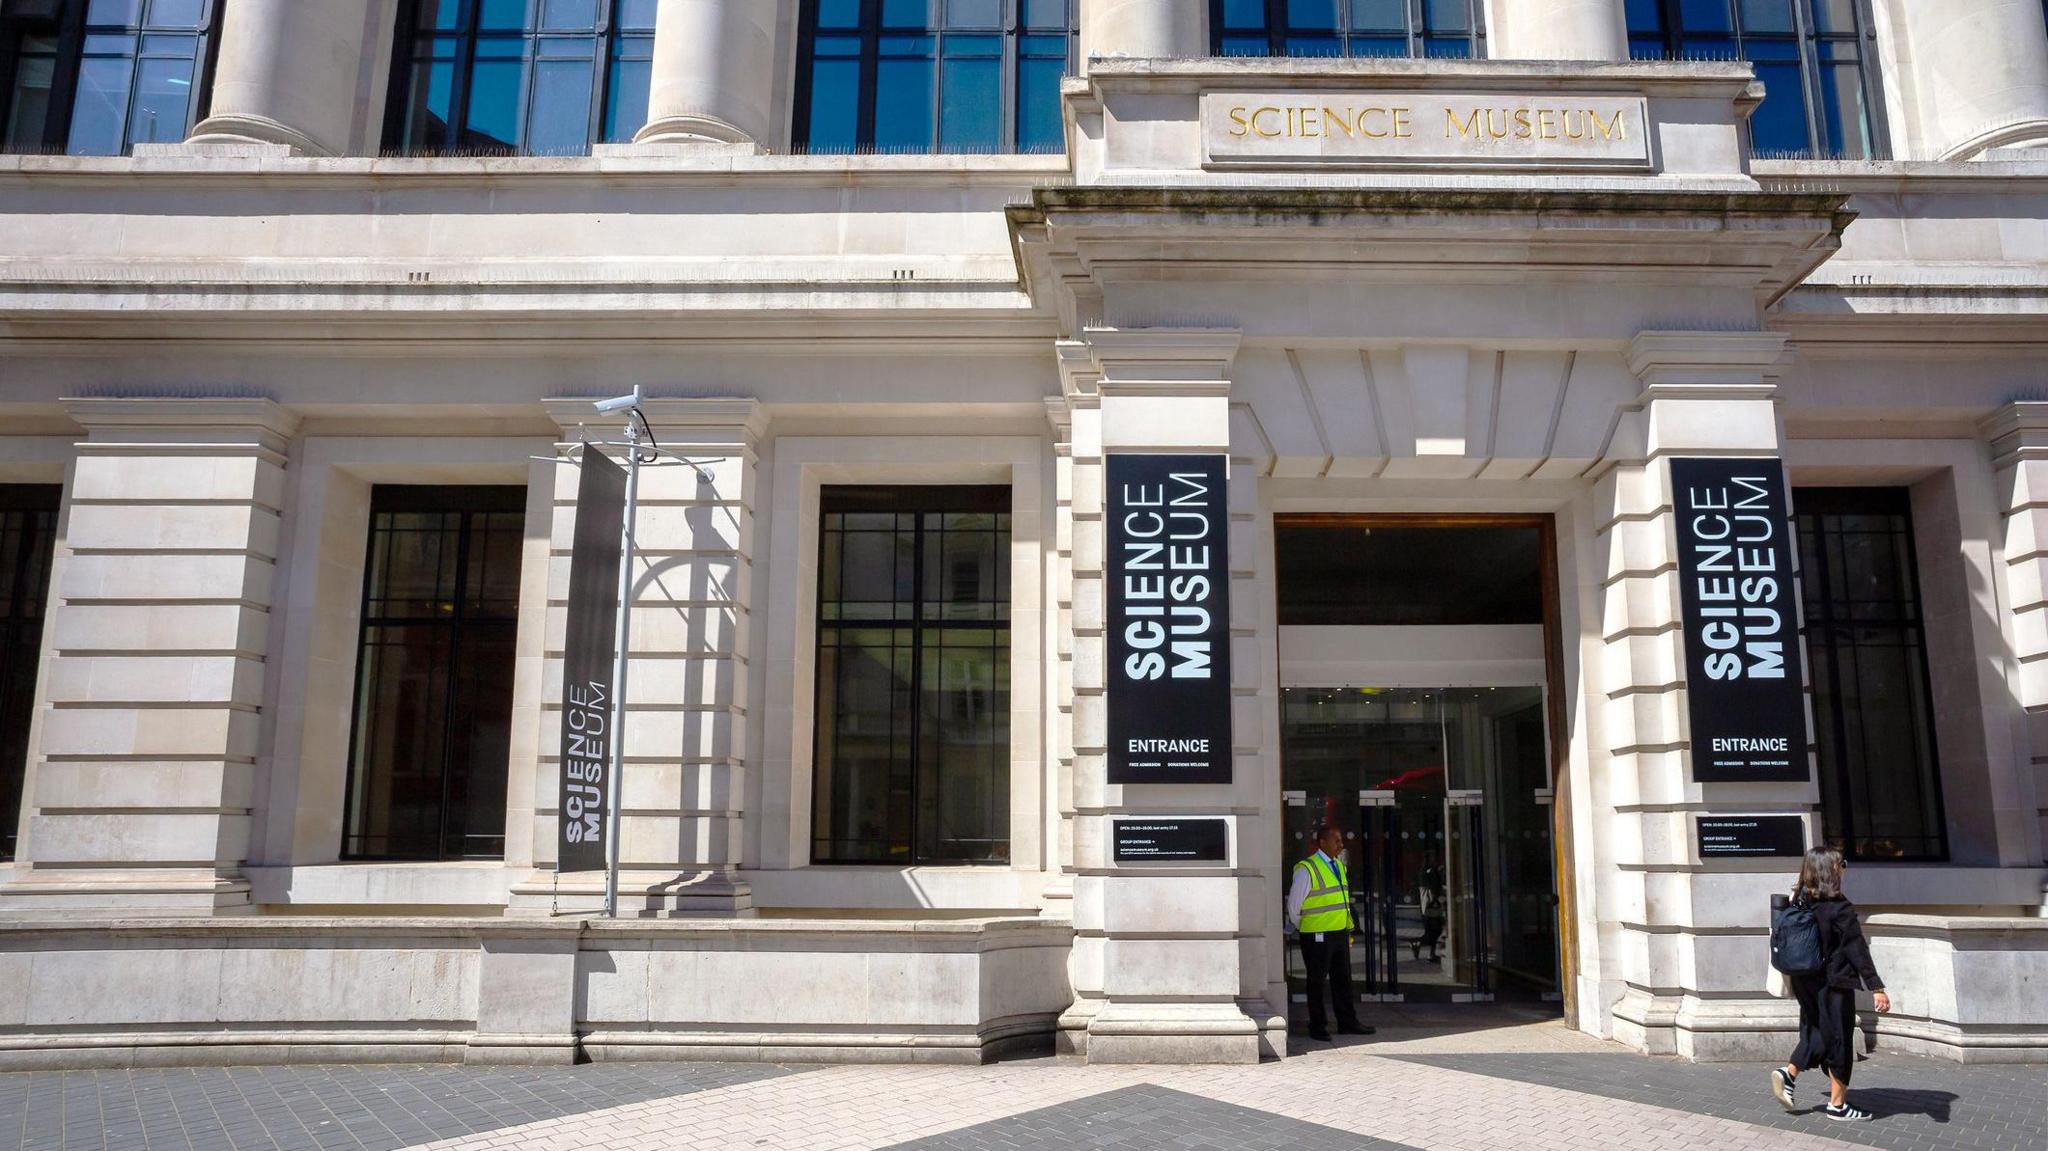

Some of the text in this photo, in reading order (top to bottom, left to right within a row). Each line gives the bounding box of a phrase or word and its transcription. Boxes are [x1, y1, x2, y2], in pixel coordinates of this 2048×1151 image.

[1228, 107, 1627, 140] SCIENCE MUSEUM
[1124, 483, 1165, 681] SCIENCE
[1169, 472, 1211, 679] MUSEUM
[1690, 487, 1742, 681] SCIENCE
[1731, 476, 1785, 679] MUSEUM
[567, 683, 588, 844] SCIENCE
[584, 680, 607, 843] MUSEUM
[1128, 739, 1209, 753] ENTRANCE
[1712, 737, 1788, 752] ENTRANCE
